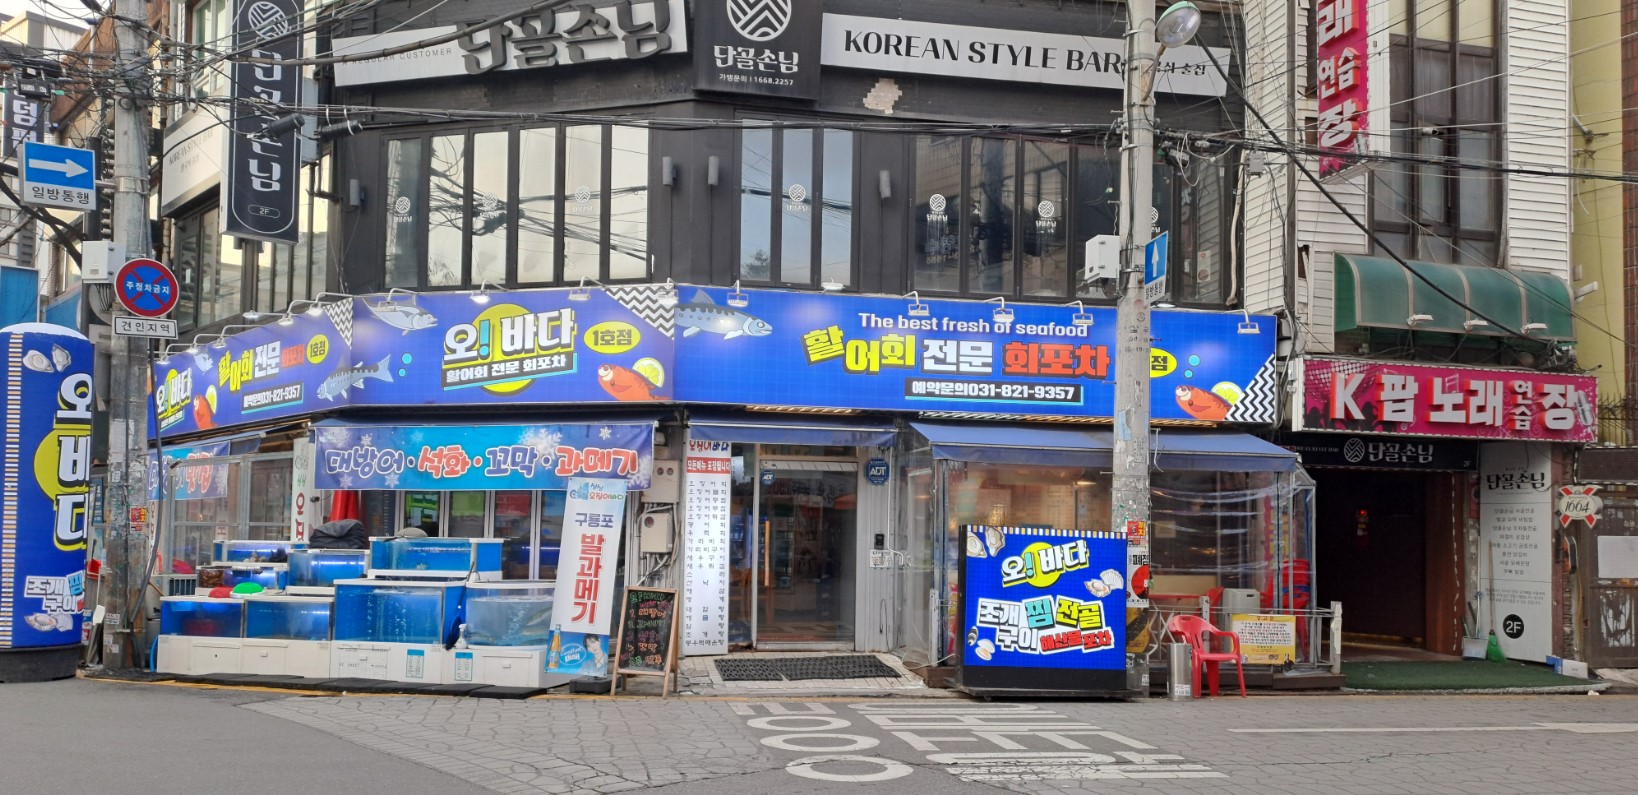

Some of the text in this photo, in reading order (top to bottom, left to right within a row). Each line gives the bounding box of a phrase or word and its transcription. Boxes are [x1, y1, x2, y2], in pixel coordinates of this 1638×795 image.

[400, 48, 452, 60] CUSTOMER
[713, 45, 799, 74] 단골손님
[844, 29, 960, 61] KOREAN
[967, 40, 1060, 69] STYLE
[1066, 50, 1122, 74] BAR
[719, 73, 794, 86] 가맹문의 1668.2257
[32, 185, 91, 205] 일방통행
[259, 207, 270, 215] 2F
[126, 281, 170, 294] 주정차금지
[121, 320, 171, 333] 견인지역
[444, 307, 576, 360] 오! 바다
[858, 312, 1089, 338] The best fresh of seafood
[592, 328, 633, 347] 1호점
[309, 339, 326, 359] 1호점
[803, 325, 1111, 379] 활어회 전문 회포차
[218, 349, 254, 391] 활어회
[254, 340, 281, 378] 전문
[446, 354, 567, 383] 활어회 전문 회포차
[169, 367, 193, 408] 바다
[324, 444, 640, 479] 대방어 석화 꼬막 과메기
[1368, 442, 1434, 464] 단골손님
[869, 466, 887, 476] ADT
[1486, 471, 1546, 491] 단골손님
[1565, 500, 1590, 513] 1664
[575, 512, 614, 528] 구룡포
[1037, 539, 1089, 573] 바다
[26, 577, 64, 596] 조개
[570, 533, 605, 625] 발과메기
[44, 595, 77, 613] 구이
[979, 598, 1102, 629] 조개 찜 전골
[1505, 620, 1522, 634] 2F
[998, 626, 1039, 649] 구이
